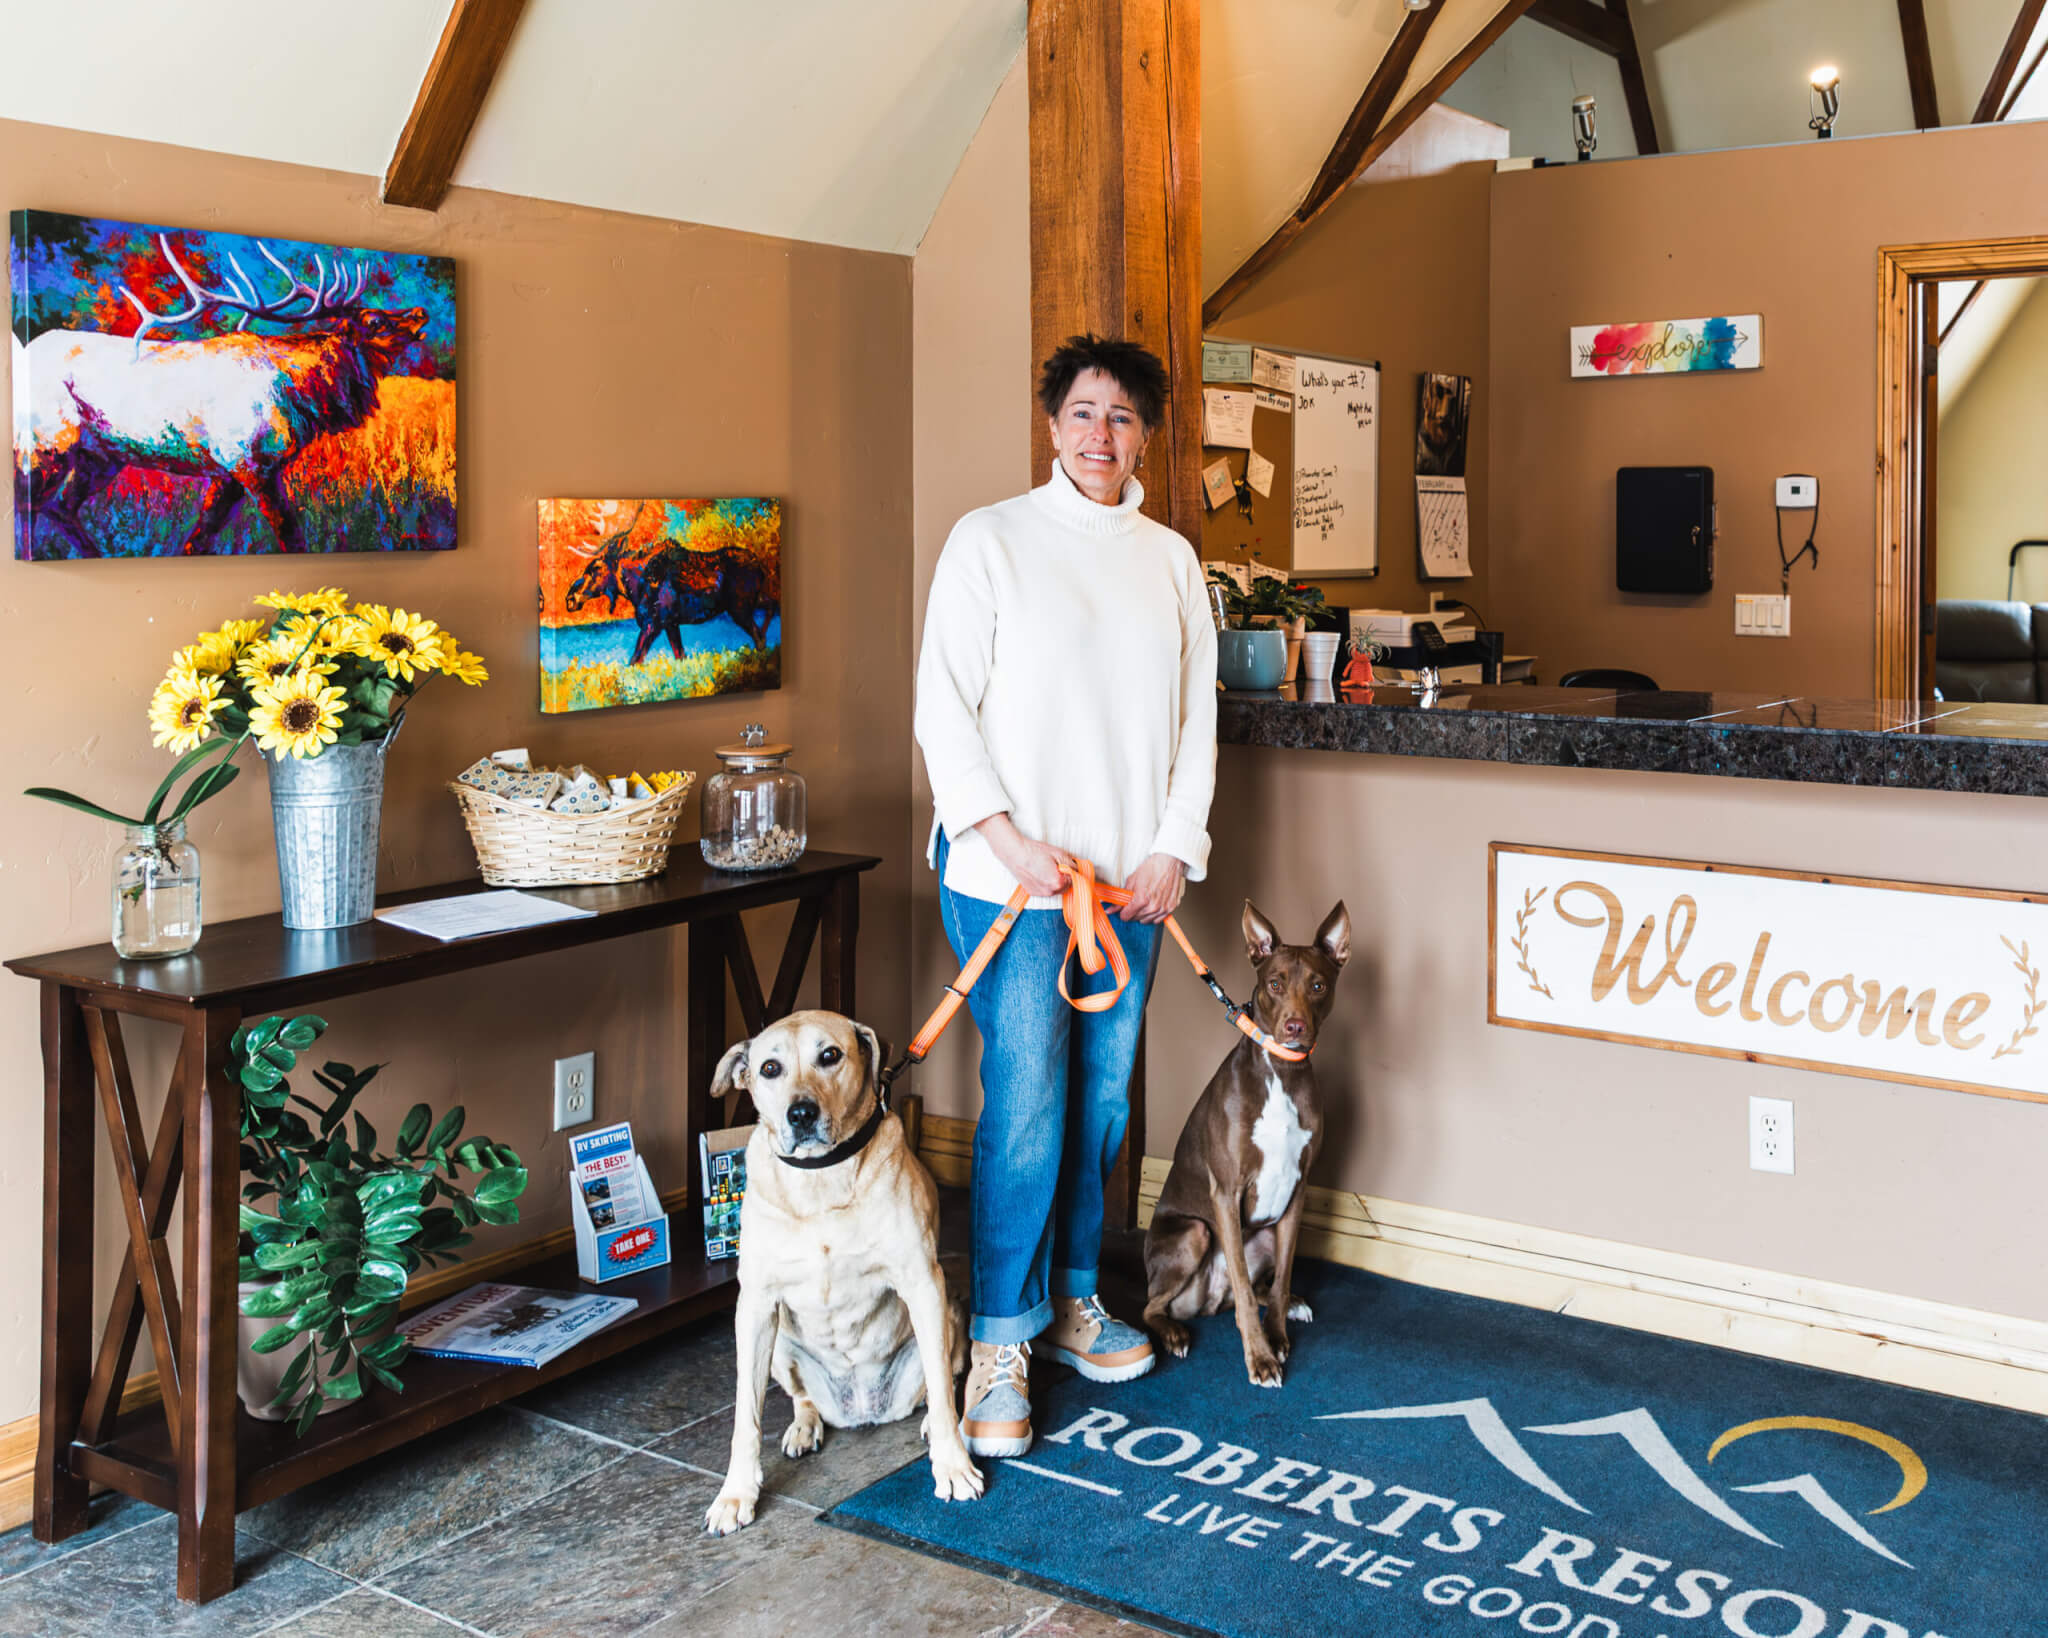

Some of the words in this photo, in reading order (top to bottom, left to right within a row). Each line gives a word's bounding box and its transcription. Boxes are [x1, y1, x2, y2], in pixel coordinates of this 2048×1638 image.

[1616, 323, 1711, 370] explore
[1553, 880, 1991, 1050] Welcome
[576, 1140, 589, 1153] RV
[590, 1130, 628, 1149] SKIRTING
[585, 1160, 602, 1173] THE
[615, 1238, 635, 1255] TAKE
[635, 1231, 651, 1247] ONE
[1044, 1406, 1506, 1553] ROBERTS
[1143, 1494, 1283, 1548] LIVE
[1289, 1531, 1415, 1588] THE
[1423, 1574, 1621, 1638] GOOD
[1505, 1526, 1949, 1638] RESO
